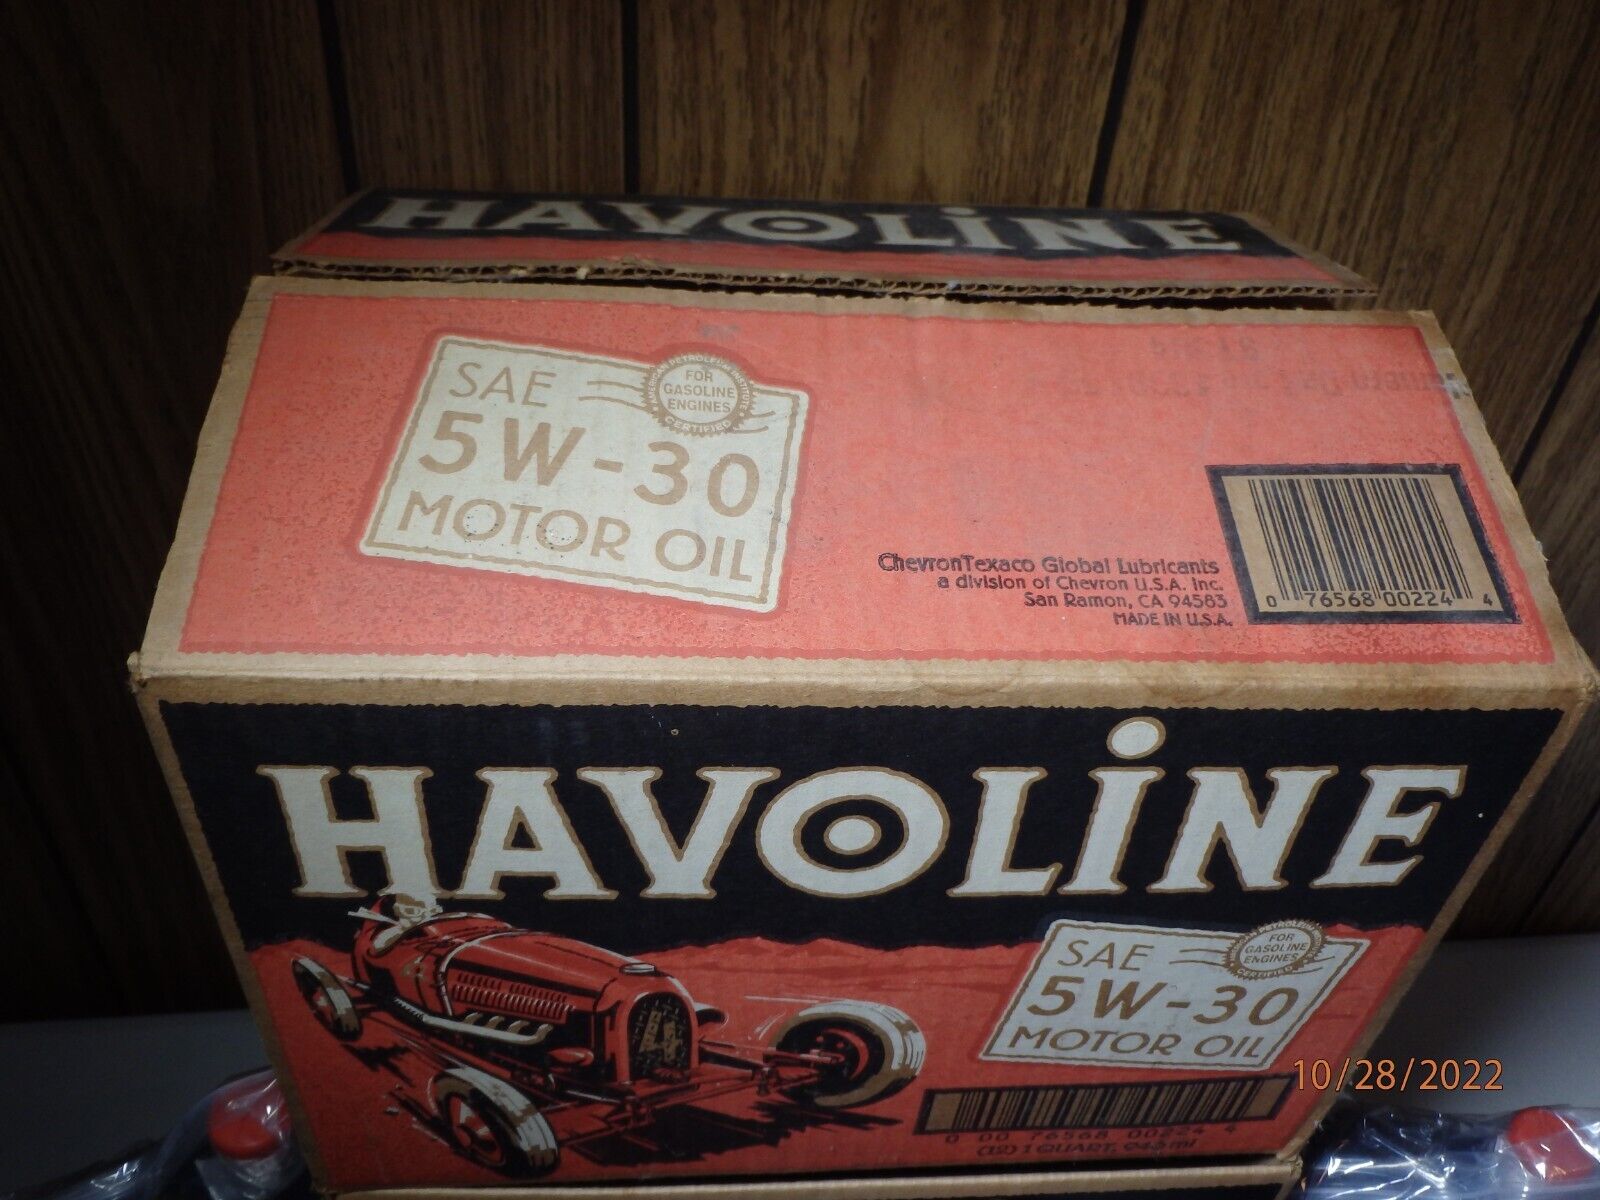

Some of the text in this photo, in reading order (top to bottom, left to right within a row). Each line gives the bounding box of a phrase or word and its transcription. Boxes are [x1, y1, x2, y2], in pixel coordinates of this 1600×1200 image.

[685, 369, 714, 382] FOR
[449, 362, 557, 408] SAE
[663, 383, 736, 399] GASOLINE
[667, 398, 731, 413] ENGINES
[664, 416, 731, 433] CERTIFIED
[397, 490, 752, 582] MOTOR OIL
[877, 552, 1220, 575] ChevronTexaco Global Lubricants
[937, 574, 1224, 592] a division of Chevron U.S.A. Inc.
[1024, 592, 1227, 609] San Ramon, CA 94583
[1265, 591, 1493, 608] 0 76568 00224 4
[1113, 612, 1233, 627] MADE IN U.S.A.
[1269, 933, 1295, 942] FOR
[1057, 940, 1154, 971] SAE
[1244, 942, 1308, 954] GASOLINE
[1244, 953, 1299, 964] ENGINES
[1008, 1026, 1264, 1058] MOTOR OIL
